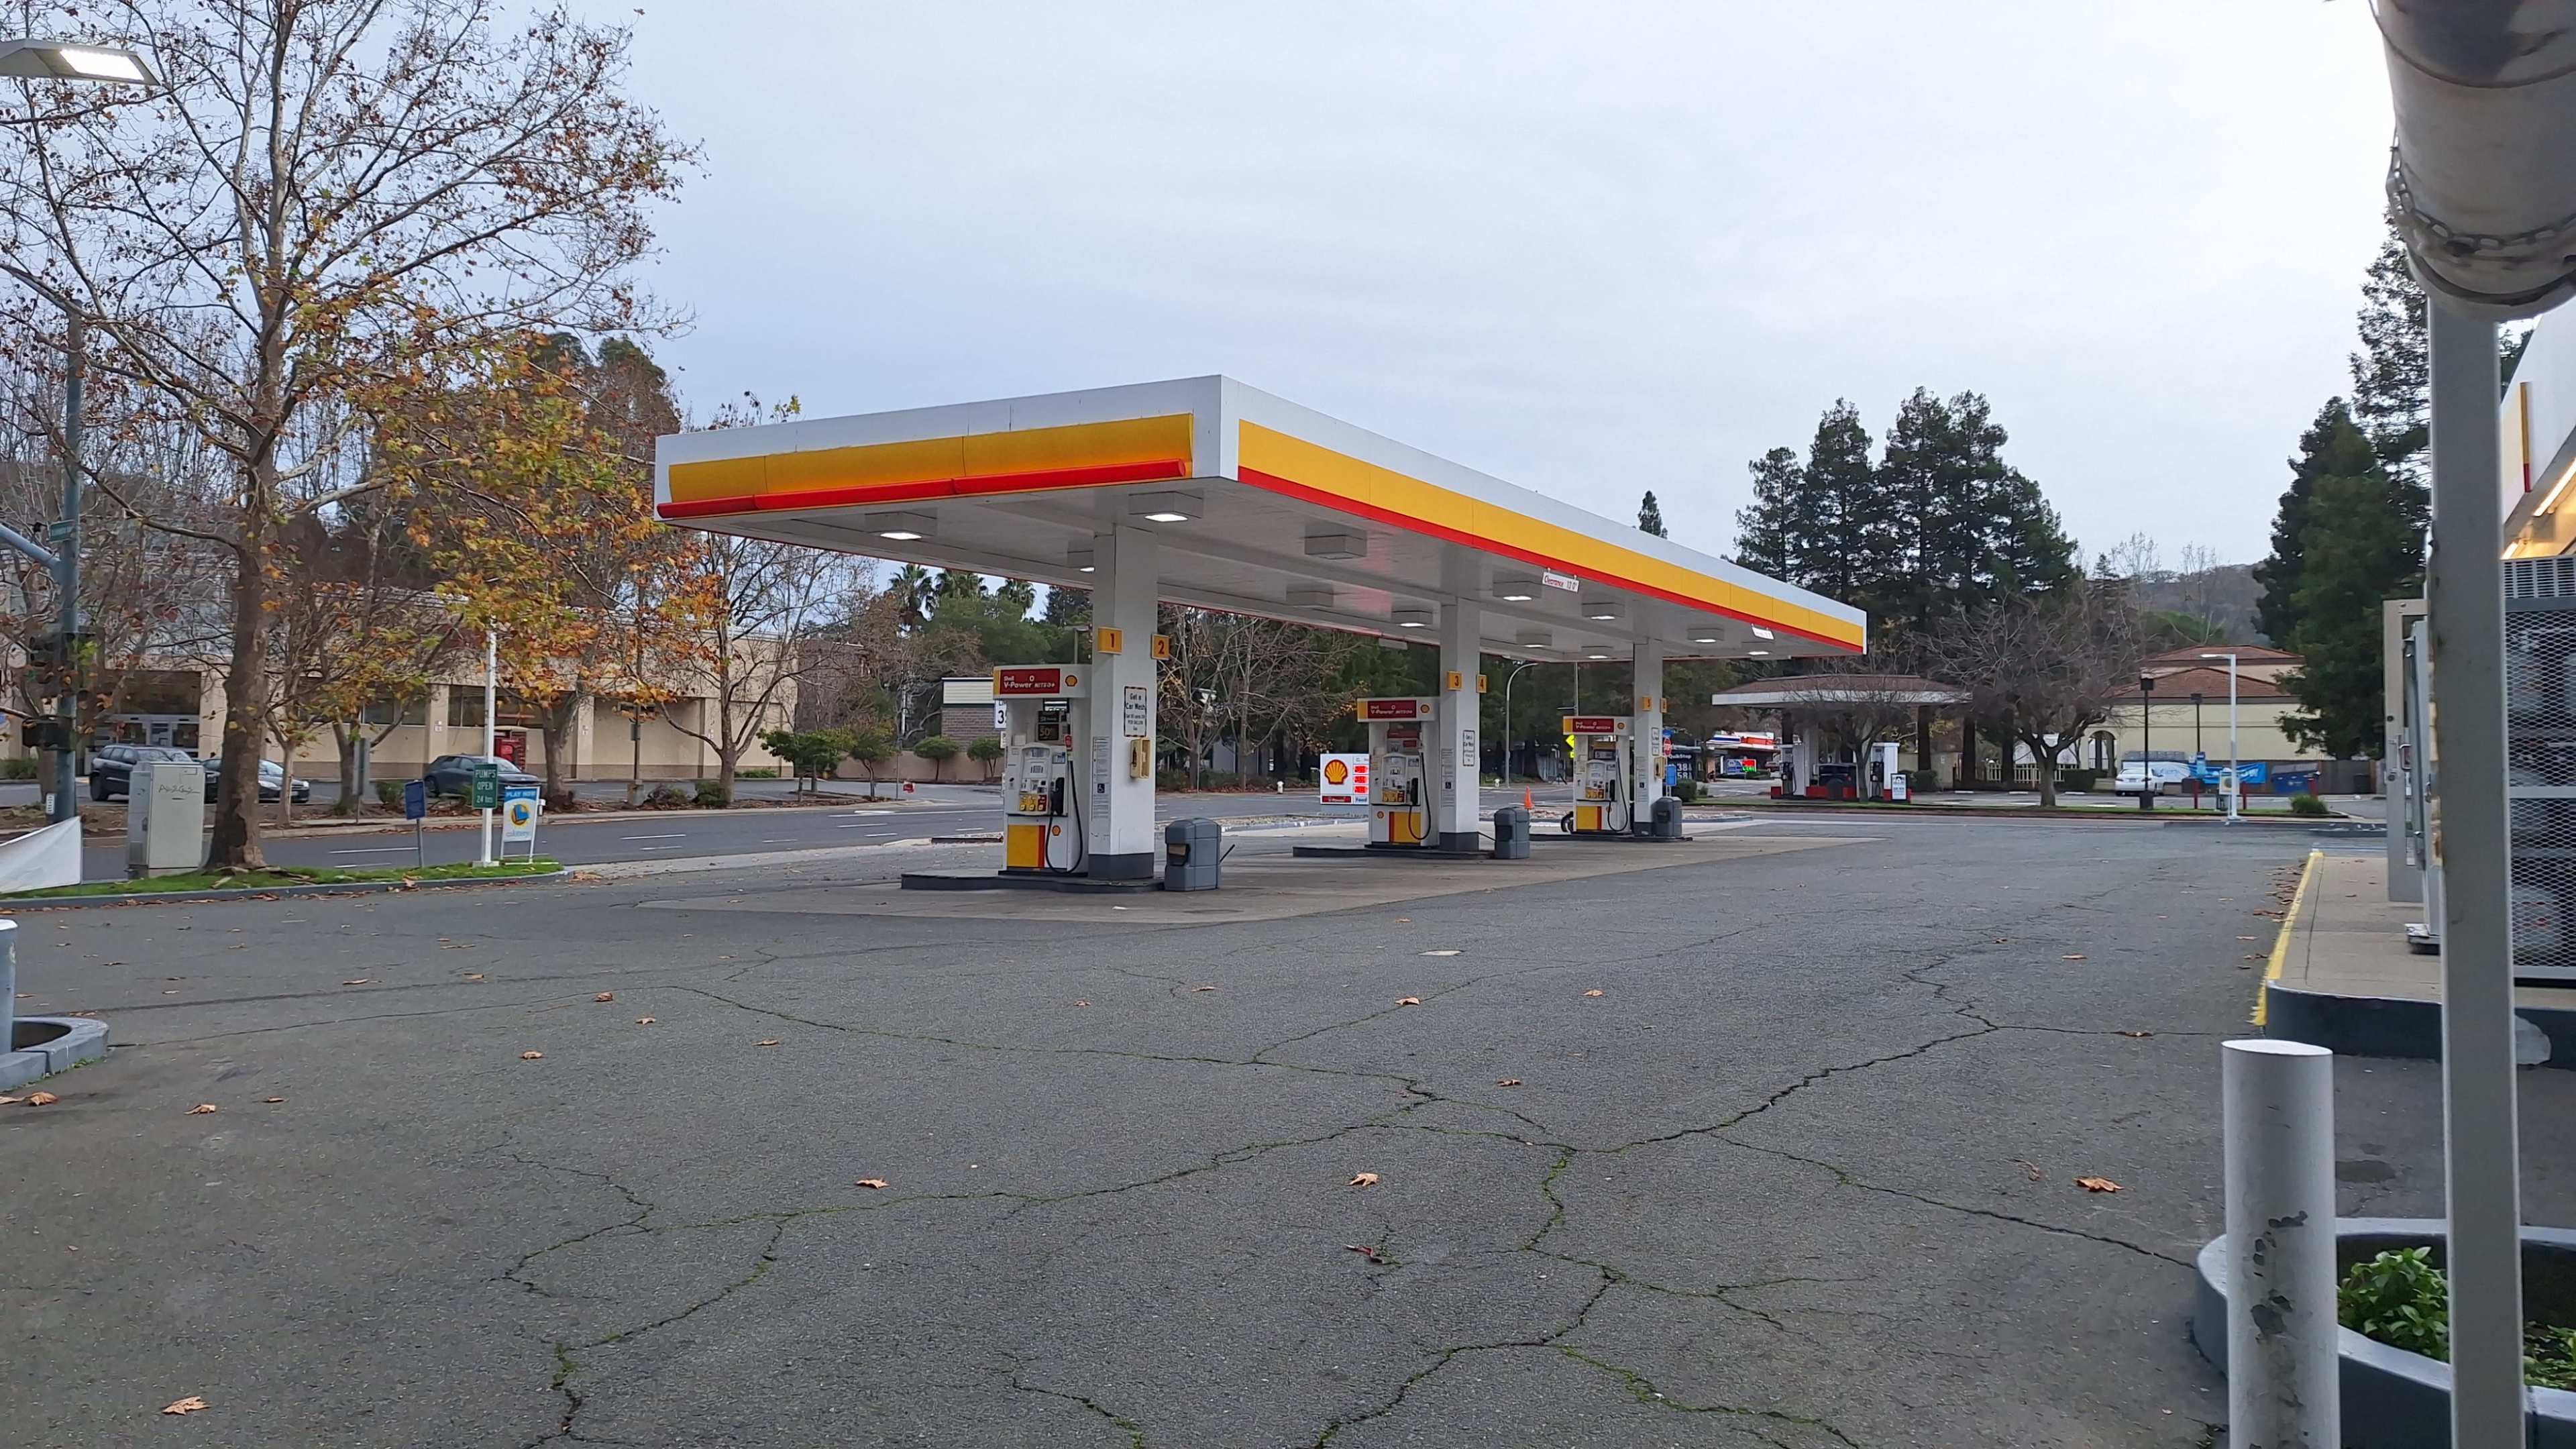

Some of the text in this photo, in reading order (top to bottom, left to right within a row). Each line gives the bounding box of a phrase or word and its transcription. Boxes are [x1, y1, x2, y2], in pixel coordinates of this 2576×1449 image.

[1110, 633, 1115, 648] 1
[1158, 640, 1165, 655] 2
[1454, 676, 1459, 687] 3
[1480, 678, 1484, 690] 4
[998, 710, 1006, 723] 3
[474, 769, 496, 779] PUMPS
[477, 782, 493, 790] OPEN
[476, 796, 484, 804] 24
